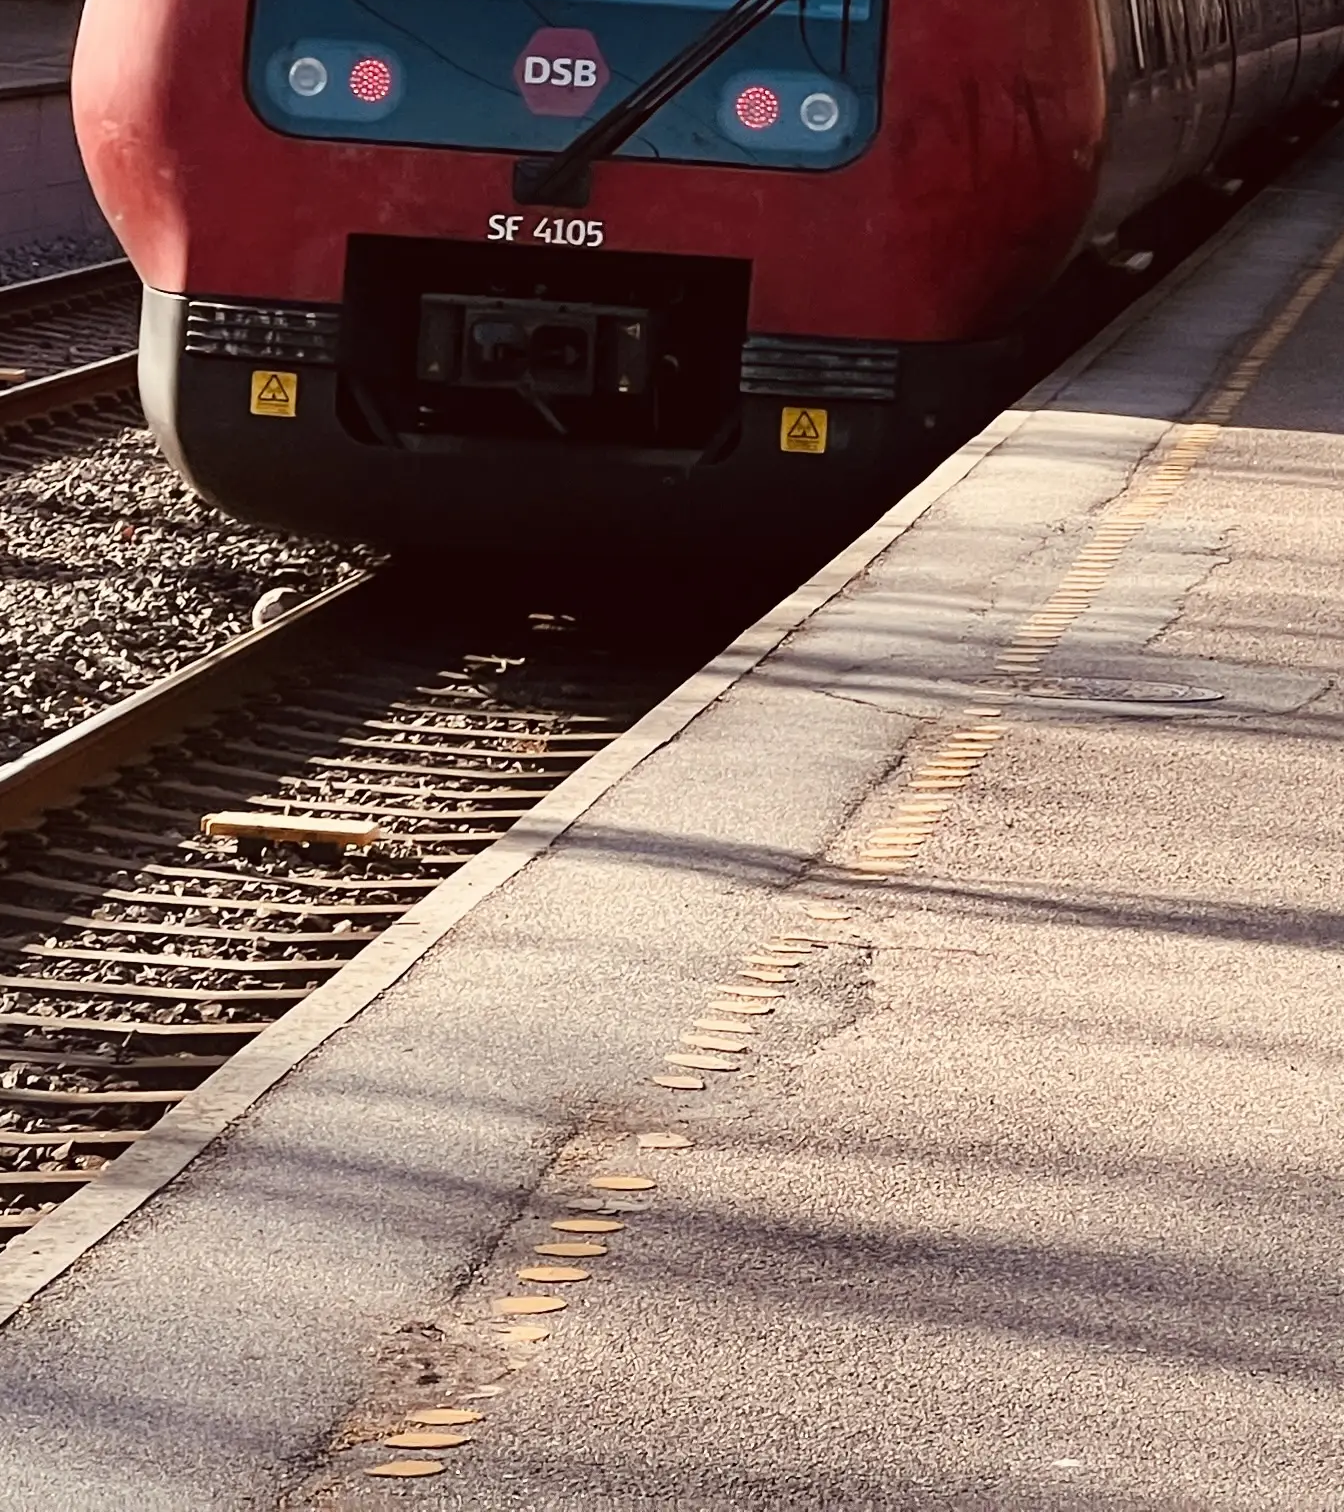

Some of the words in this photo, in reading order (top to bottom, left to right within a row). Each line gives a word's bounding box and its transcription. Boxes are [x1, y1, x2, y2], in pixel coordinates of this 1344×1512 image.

[523, 55, 598, 88] DSB
[486, 214, 524, 241] SF
[532, 217, 605, 248] 4105
